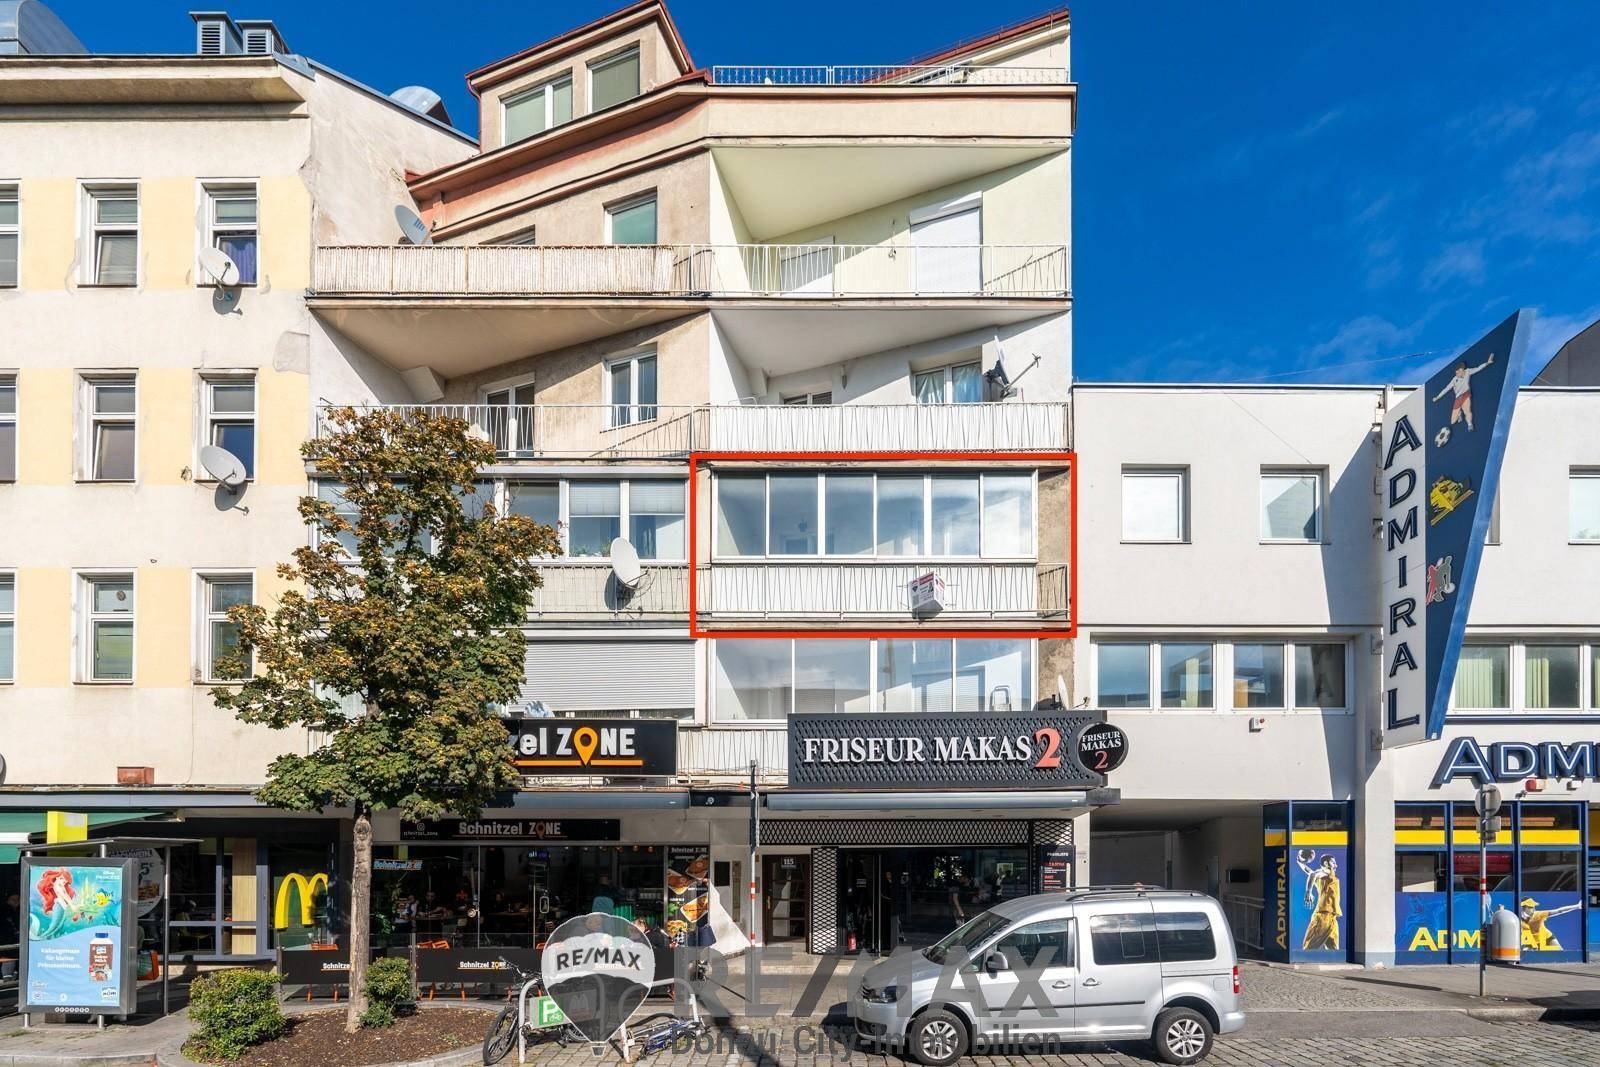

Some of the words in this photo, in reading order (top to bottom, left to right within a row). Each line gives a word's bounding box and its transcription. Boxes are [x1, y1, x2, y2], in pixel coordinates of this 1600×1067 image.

[1383, 413, 1423, 730] ADMIRAL
[555, 726, 636, 767] ZONE
[803, 737, 926, 763] FRISEUR
[934, 736, 1032, 761] MAKAS
[1034, 728, 1062, 769] 2
[1081, 731, 1121, 742] FRISEUR
[1081, 739, 1122, 751] MAKAS
[1094, 750, 1109, 769] 2
[1432, 736, 1600, 788] ADM
[459, 821, 523, 835] Schnitzel
[528, 821, 561, 839] ZONE
[1275, 850, 1287, 950] ADMIRAL
[1408, 926, 1562, 952] ADMAL
